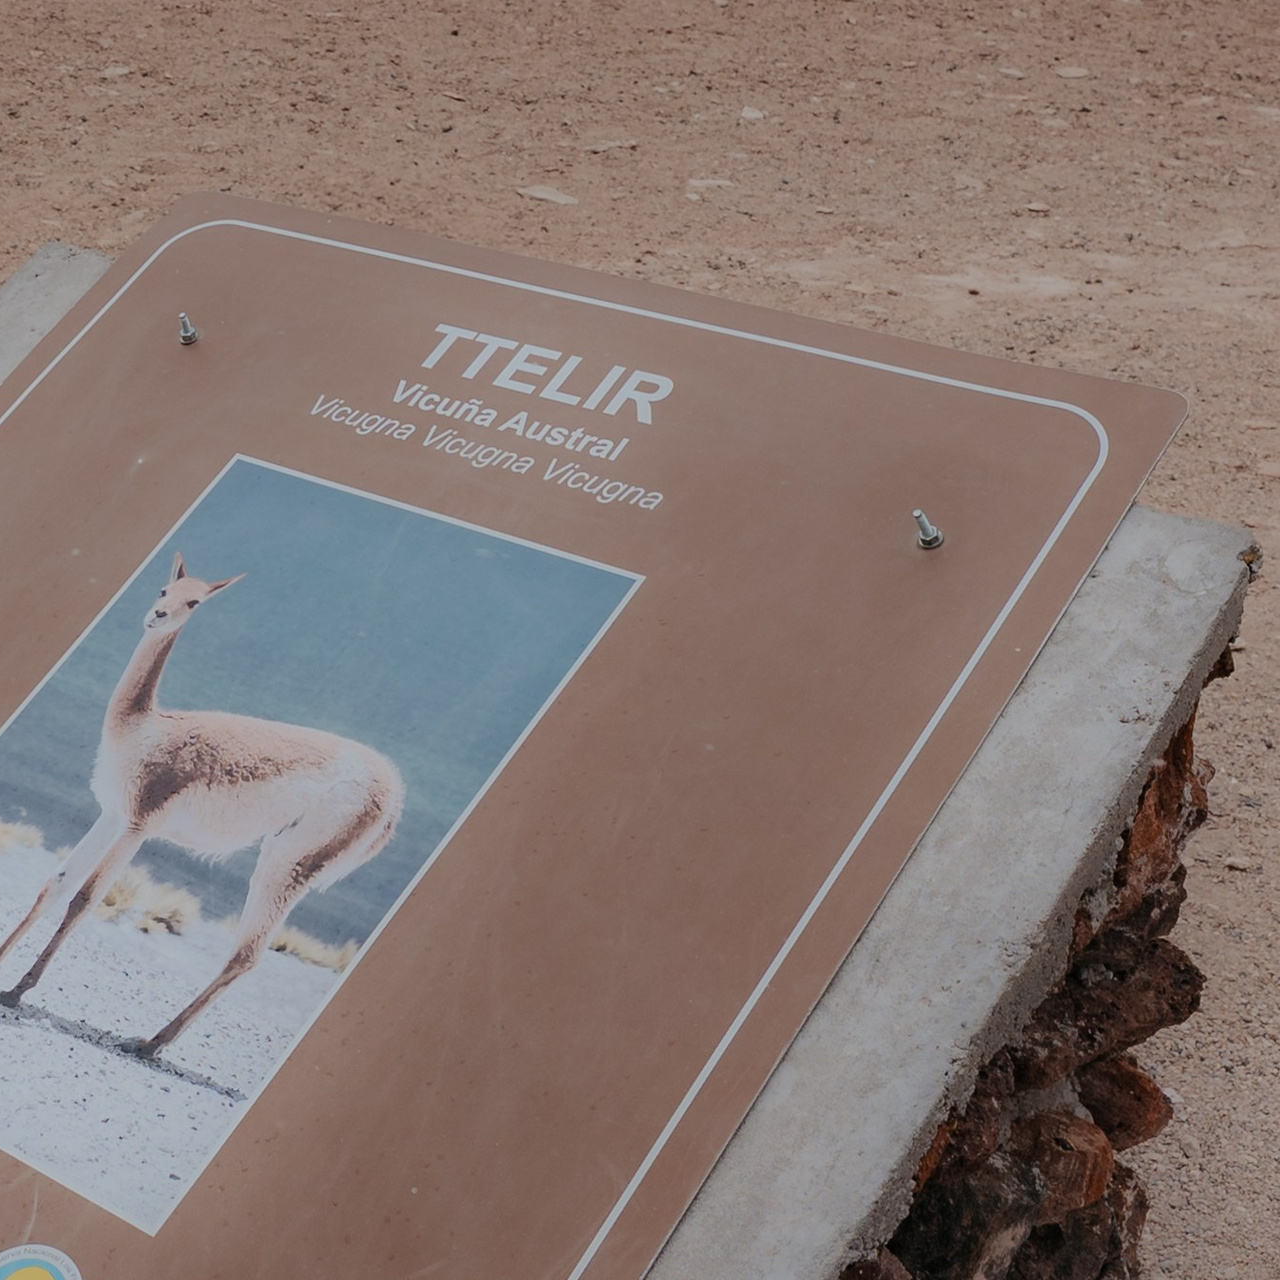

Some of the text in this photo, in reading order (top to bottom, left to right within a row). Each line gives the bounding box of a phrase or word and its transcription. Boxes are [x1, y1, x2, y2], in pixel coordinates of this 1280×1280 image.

[392, 379, 630, 462] Vicuña Austral
[421, 323, 674, 425] TTELIR
[309, 394, 664, 511] Vicugna Vicugna Vicugna
